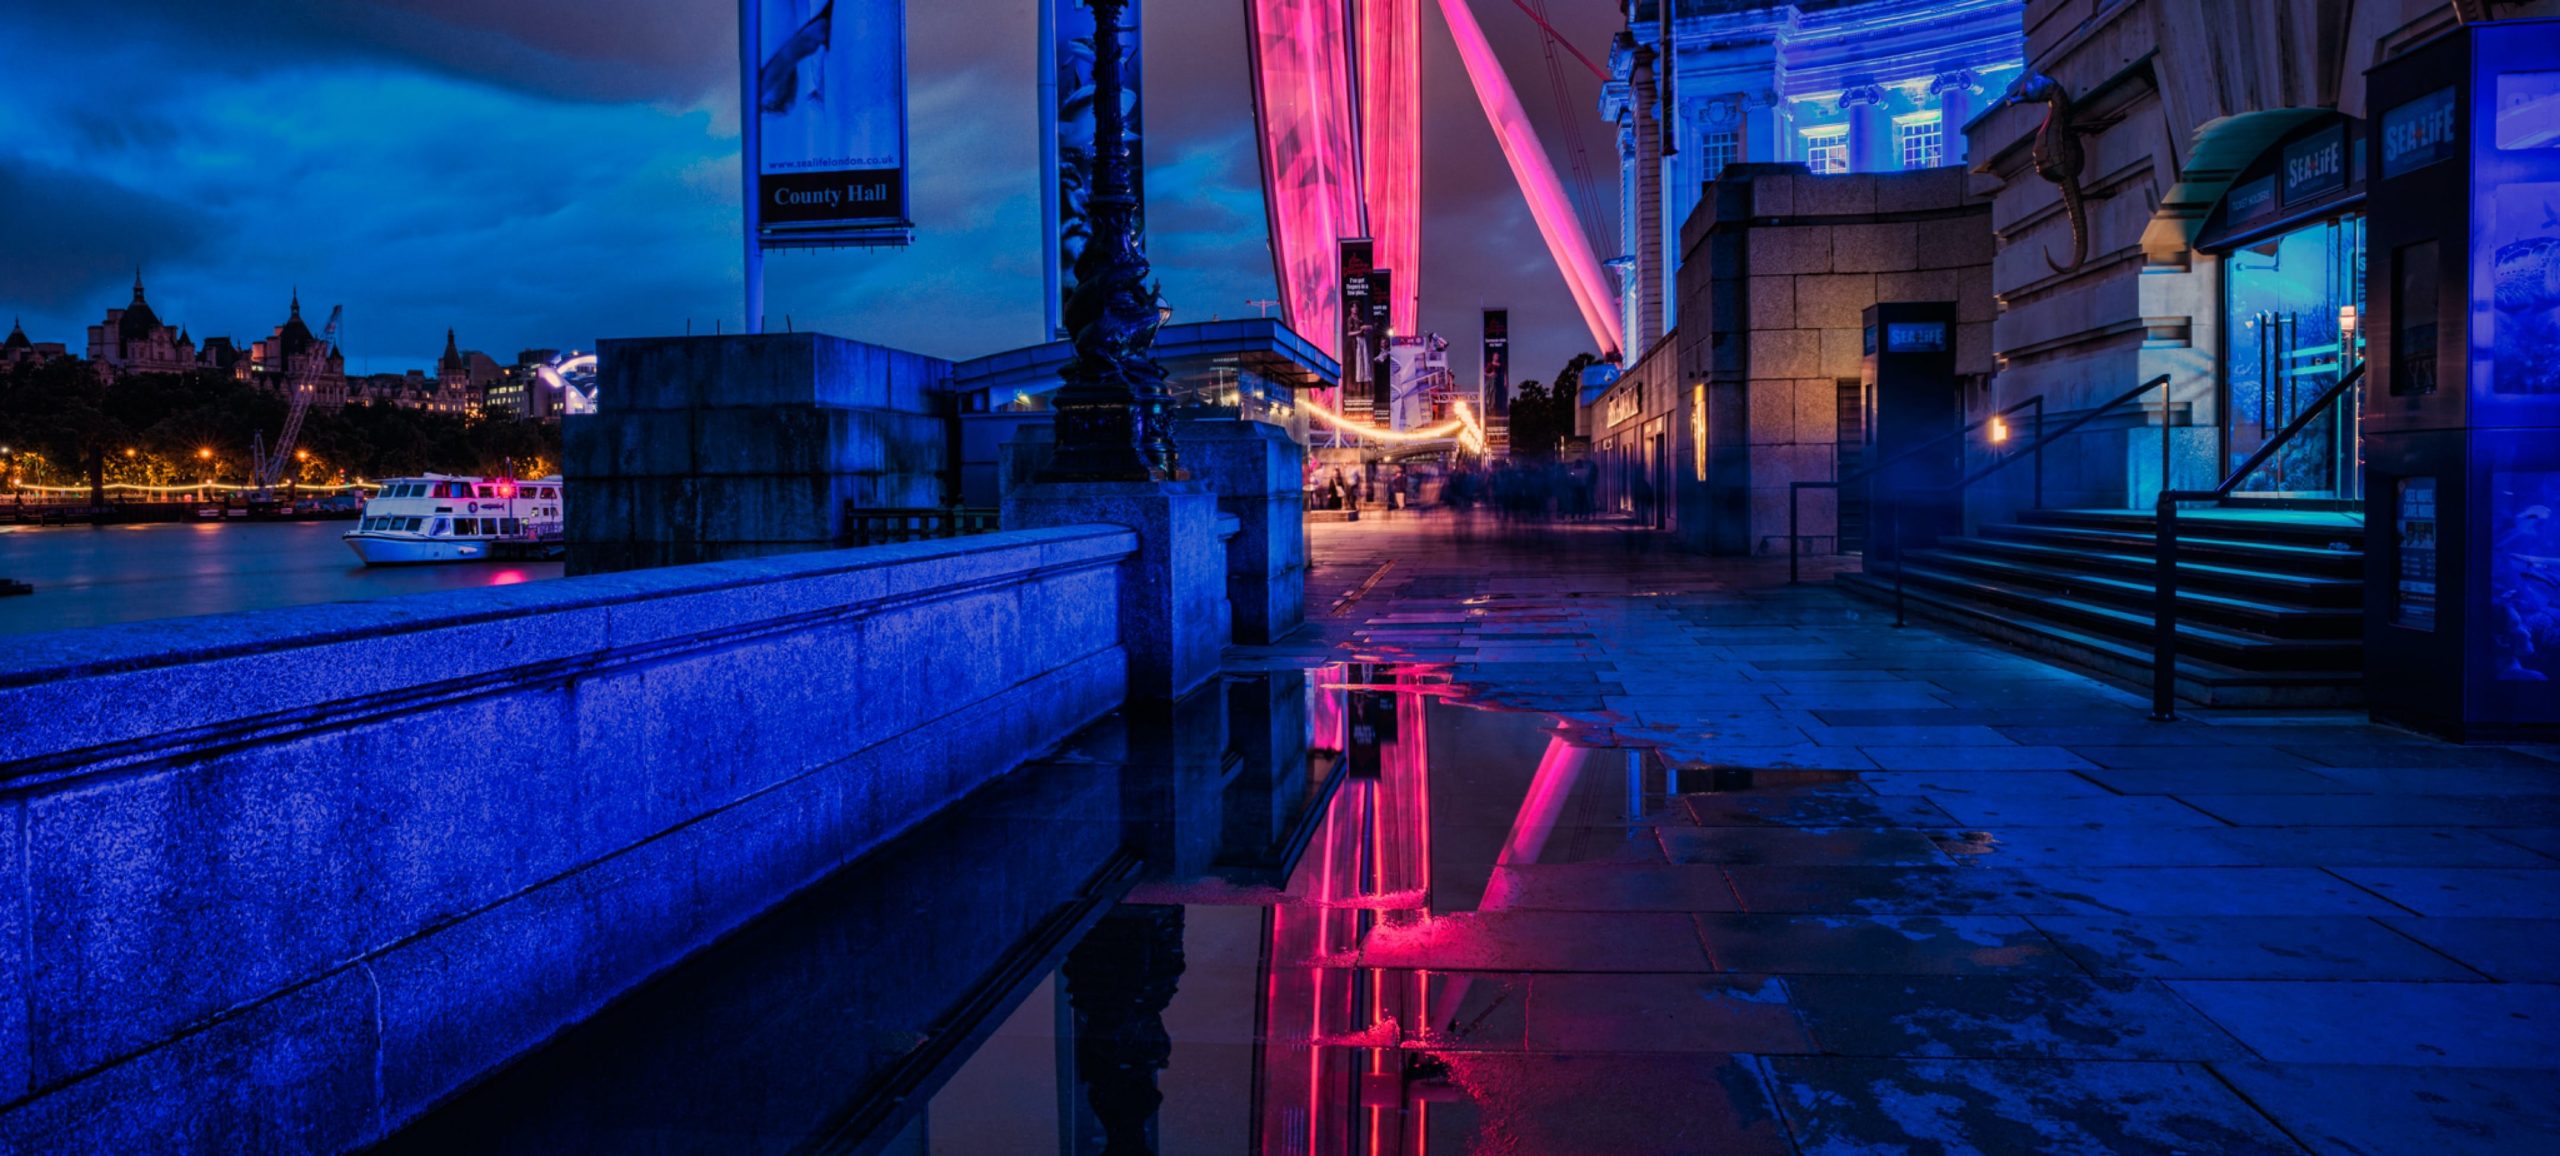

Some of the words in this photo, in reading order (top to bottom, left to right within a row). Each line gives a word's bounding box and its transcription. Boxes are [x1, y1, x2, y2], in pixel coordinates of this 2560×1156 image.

[2386, 120, 2417, 162] SEA
[768, 155, 895, 169] www.sealifelondon.co.uk
[2289, 154, 2312, 189] SEA
[774, 186, 842, 208] County
[847, 183, 887, 202] Hall
[1891, 329, 1916, 345] SEA
